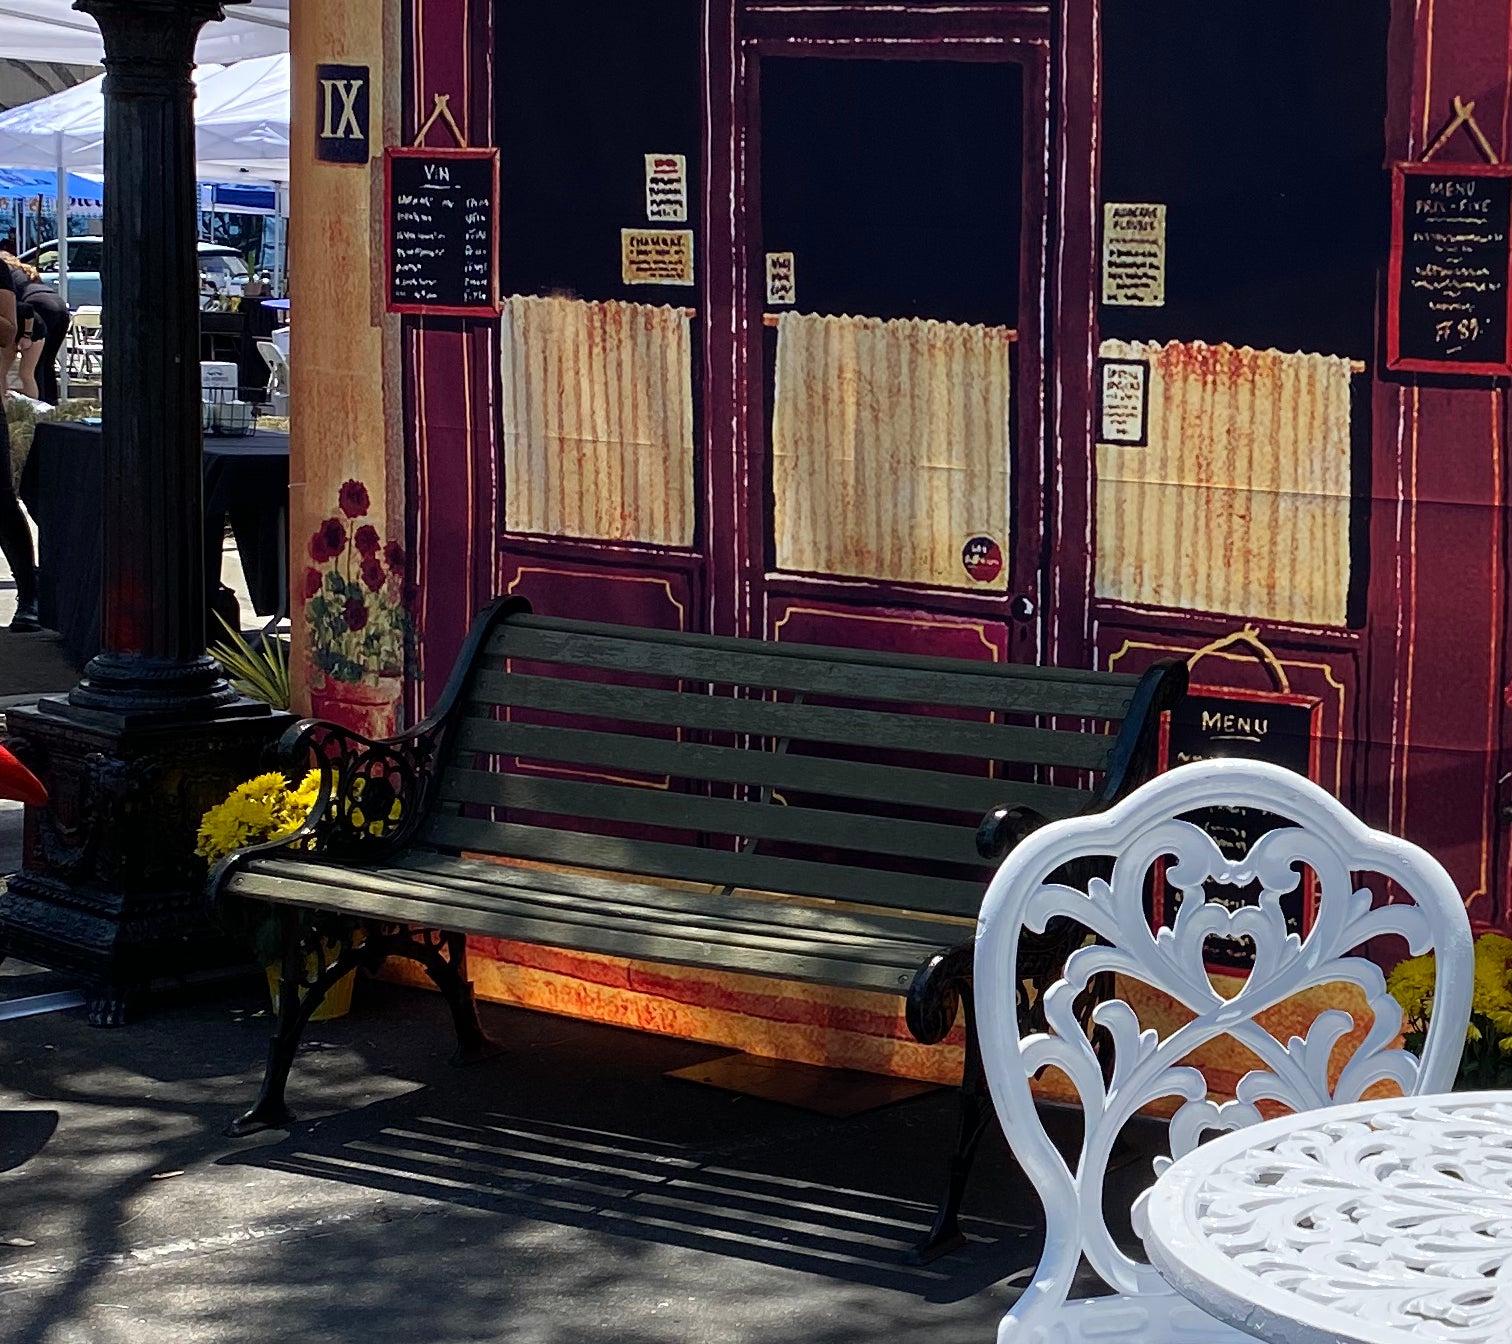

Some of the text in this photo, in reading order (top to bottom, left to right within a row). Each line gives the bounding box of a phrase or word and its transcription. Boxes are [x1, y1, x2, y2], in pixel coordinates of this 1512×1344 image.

[320, 79, 365, 139] IX
[1430, 181, 1476, 197] MENU
[1202, 710, 1268, 735] MENU
